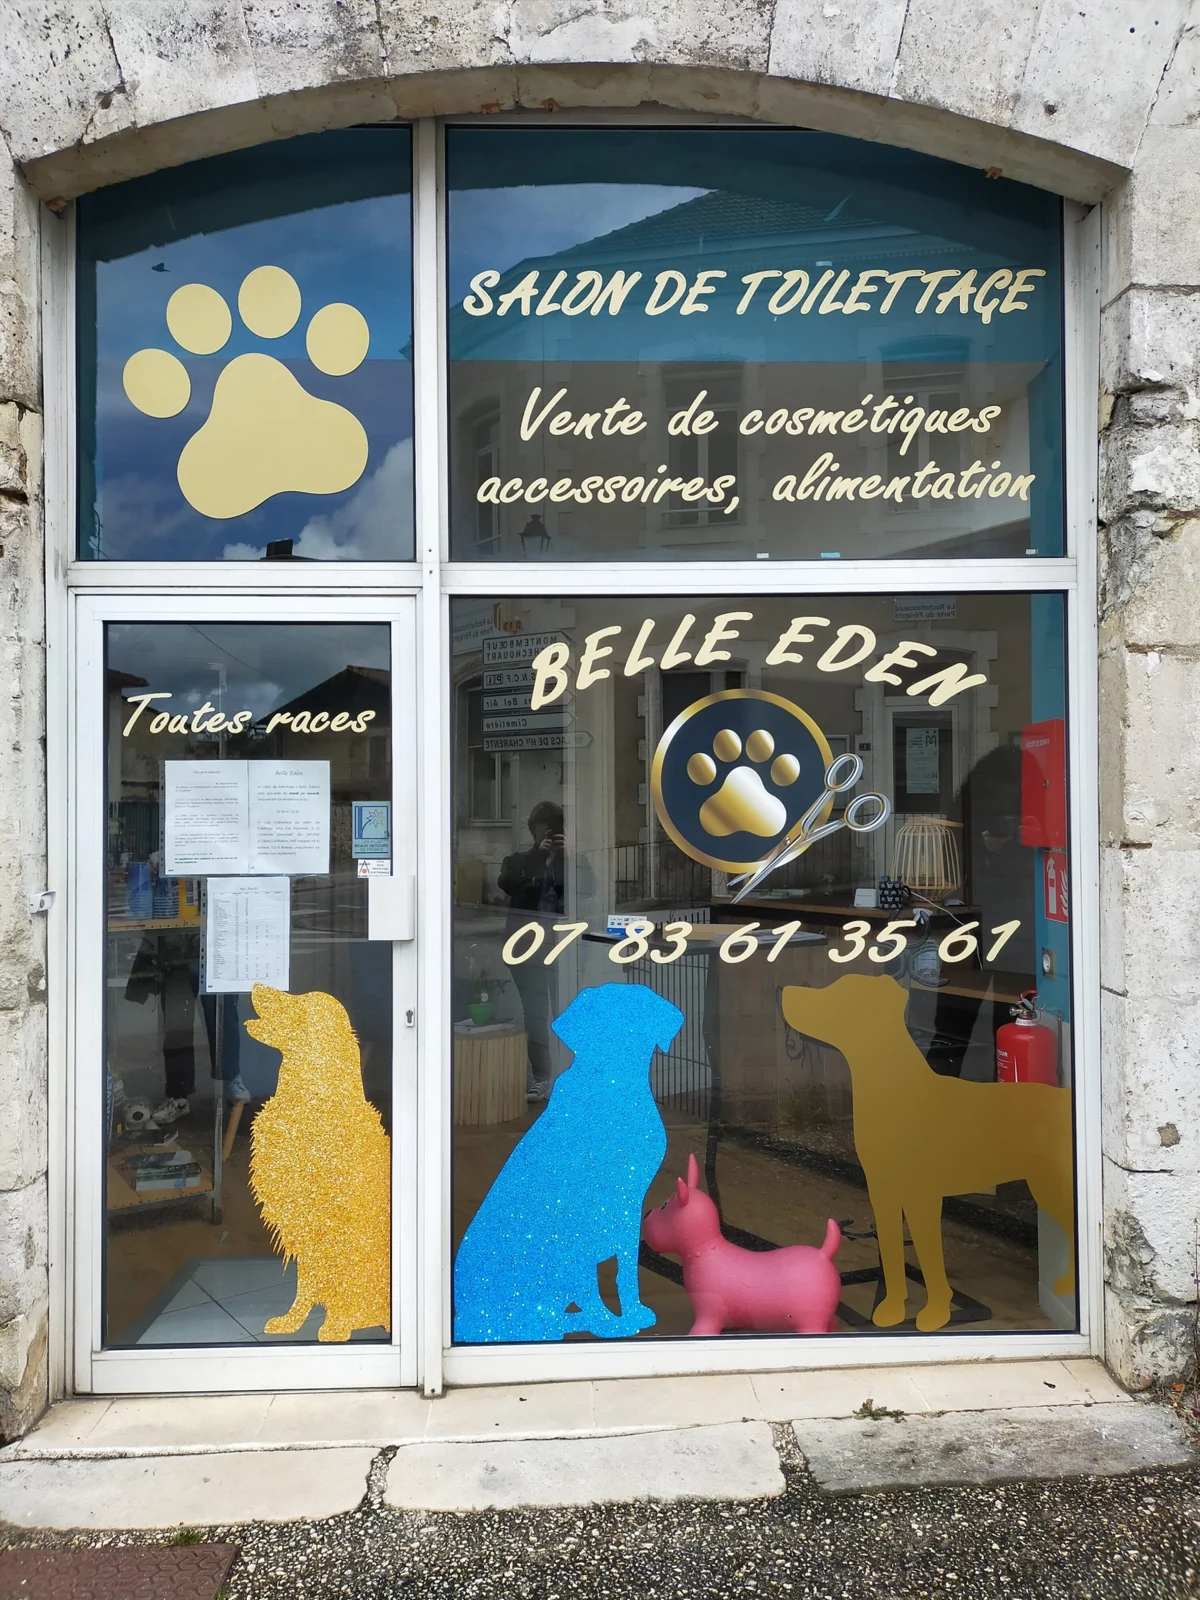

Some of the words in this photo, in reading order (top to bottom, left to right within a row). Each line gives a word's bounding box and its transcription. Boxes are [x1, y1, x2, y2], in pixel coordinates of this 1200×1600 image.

[463, 271, 640, 315] SALON
[646, 271, 725, 315] DE
[736, 269, 1046, 323] TOILETTAGE
[520, 387, 648, 442] Vente
[667, 390, 718, 436] de
[739, 393, 1002, 456] cosmétiques
[476, 464, 740, 514] accessoires,
[772, 452, 1035, 502] alimentation
[530, 610, 755, 711] BELLE
[765, 615, 988, 708] EDEN
[122, 692, 253, 737] Toutes
[266, 709, 376, 734] races
[502, 921, 589, 965] 07
[608, 921, 693, 965] 83
[719, 921, 802, 964] 61
[828, 920, 917, 963] 35
[937, 920, 1021, 963] 61
